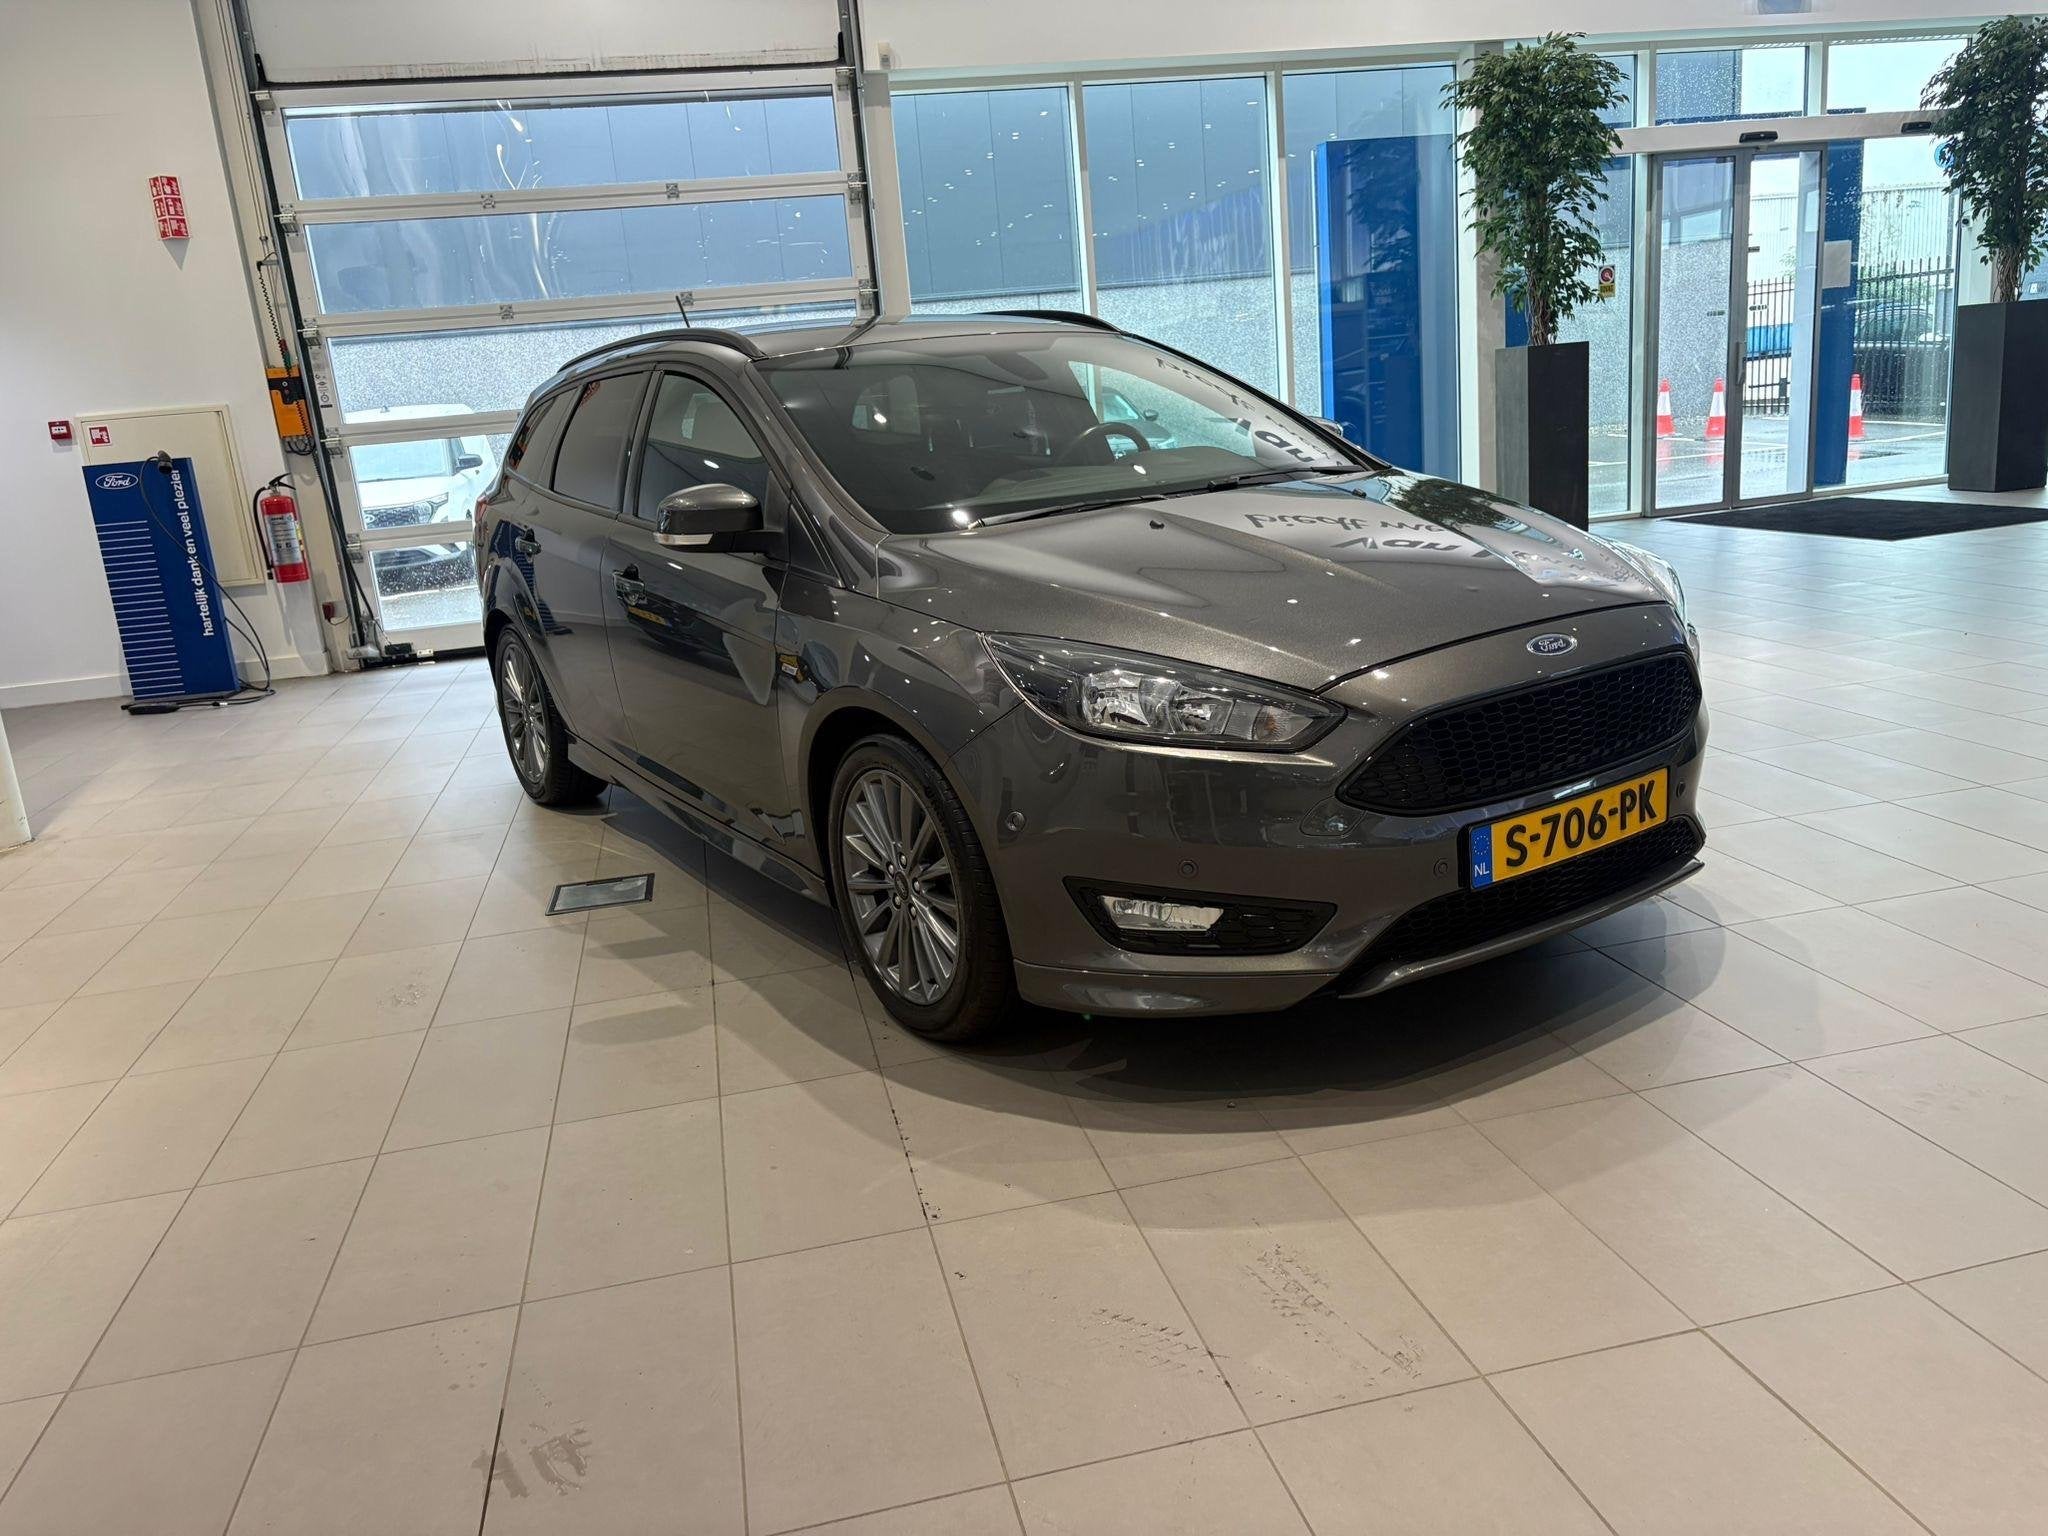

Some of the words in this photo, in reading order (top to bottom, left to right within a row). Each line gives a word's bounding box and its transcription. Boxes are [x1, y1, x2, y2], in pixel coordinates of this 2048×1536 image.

[103, 475, 131, 487] Ford
[177, 511, 193, 538] veel
[184, 538, 197, 554] en
[187, 556, 204, 586] dank
[194, 587, 215, 636] hartelijk
[1538, 638, 1566, 652] Ford
[1505, 779, 1657, 868] S-706-PK
[1474, 863, 1490, 878] NL
